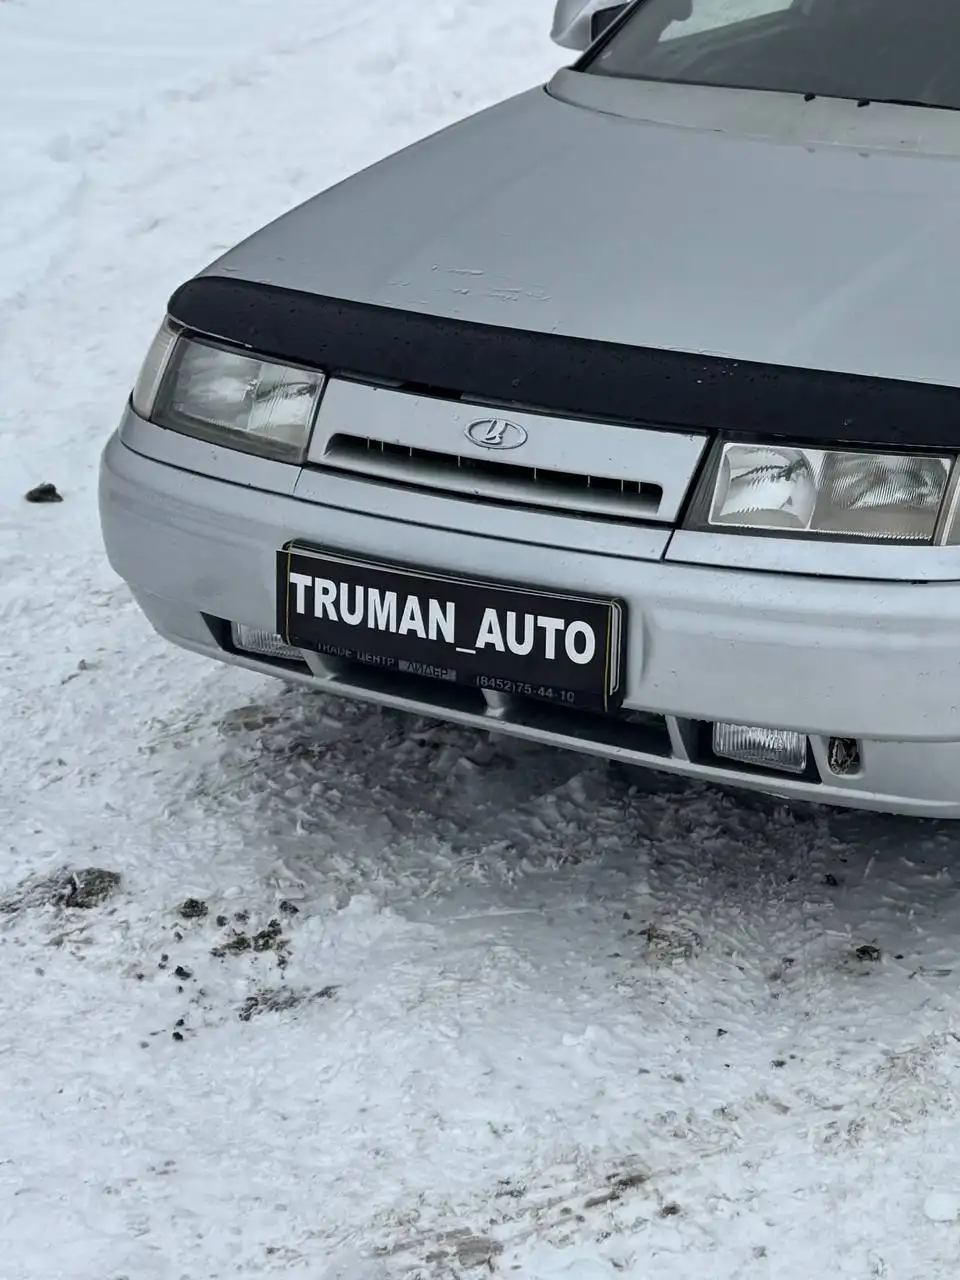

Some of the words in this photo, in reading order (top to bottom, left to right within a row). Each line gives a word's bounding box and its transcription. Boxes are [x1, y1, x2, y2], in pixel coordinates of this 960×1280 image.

[289, 571, 596, 665] TRUMAN_AUTO
[357, 650, 395, 666] ЦЕНТР
[476, 675, 576, 702] (8452)75-44-10
